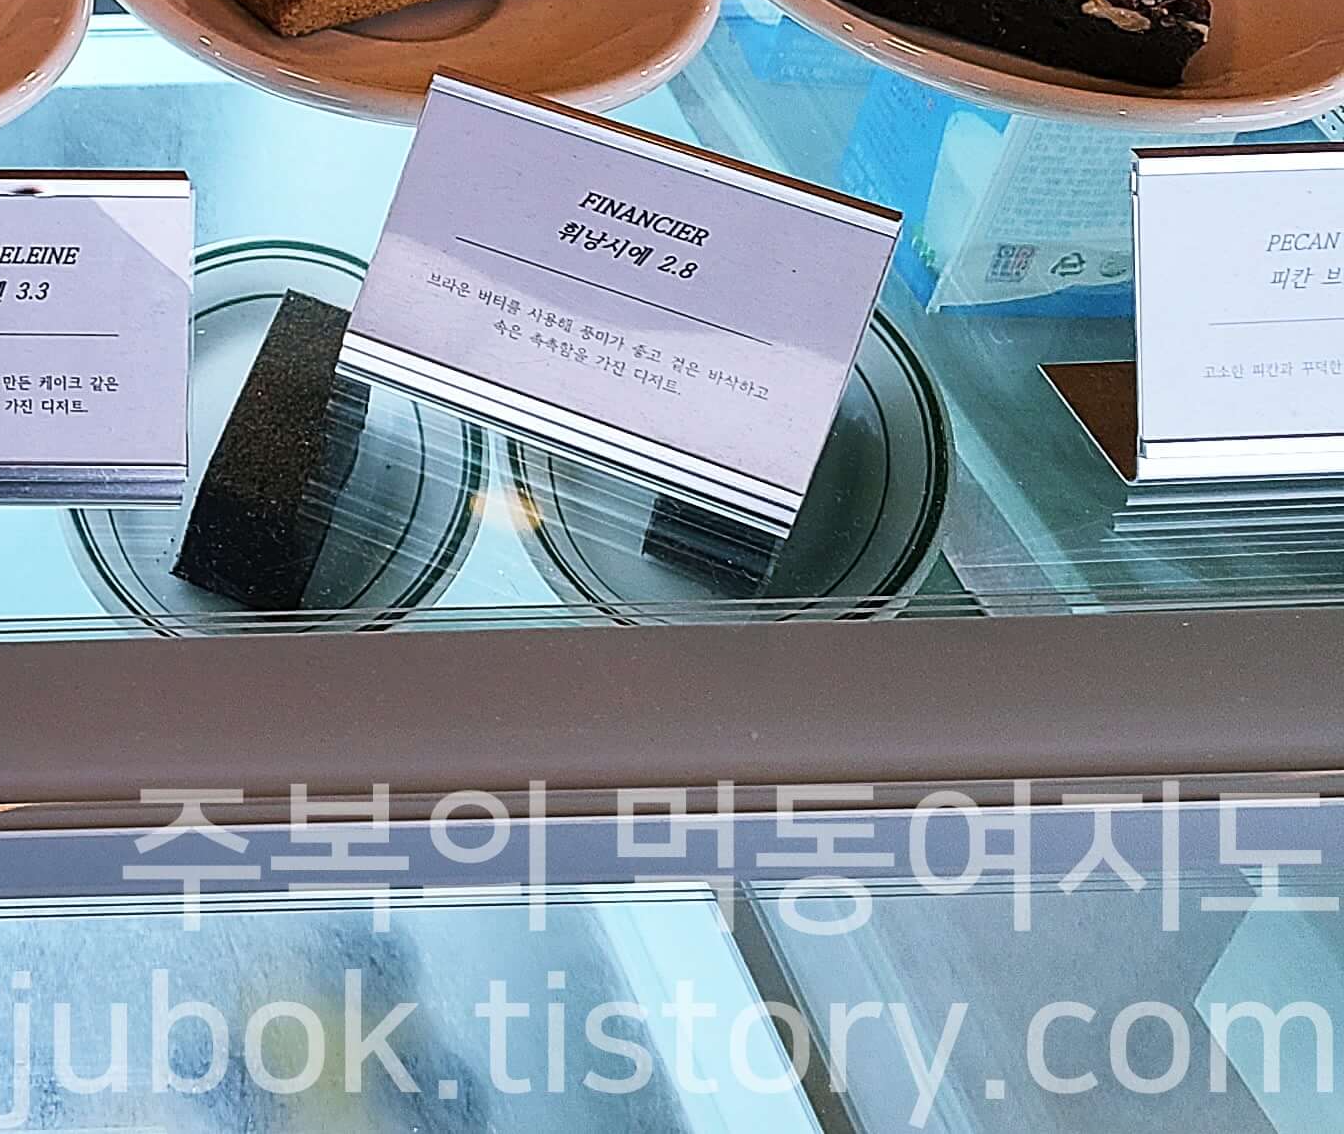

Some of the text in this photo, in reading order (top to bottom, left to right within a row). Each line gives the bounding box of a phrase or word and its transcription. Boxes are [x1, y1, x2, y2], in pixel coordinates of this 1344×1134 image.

[578, 191, 710, 247] FINANCIER
[558, 221, 699, 279] 휘낭시에 2.8
[1265, 232, 1342, 252] PECAN
[1270, 267, 1315, 290] 피칸
[15, 281, 50, 301] 3.3
[426, 272, 471, 298] 브라운
[478, 289, 521, 315] 버터를
[527, 307, 574, 334] 사용해
[580, 325, 625, 352] 풍미가
[632, 344, 662, 363] 좋고
[708, 369, 769, 401] 바삭하고
[494, 319, 681, 395] 속은 촉촉함을 가진 디저트.
[1202, 363, 1245, 378] 고소한
[1252, 362, 1294, 378] 피칸과
[3, 374, 32, 391] 만든
[39, 374, 82, 391] 케이크
[89, 376, 119, 392] 같은
[4, 398, 33, 415] 가진
